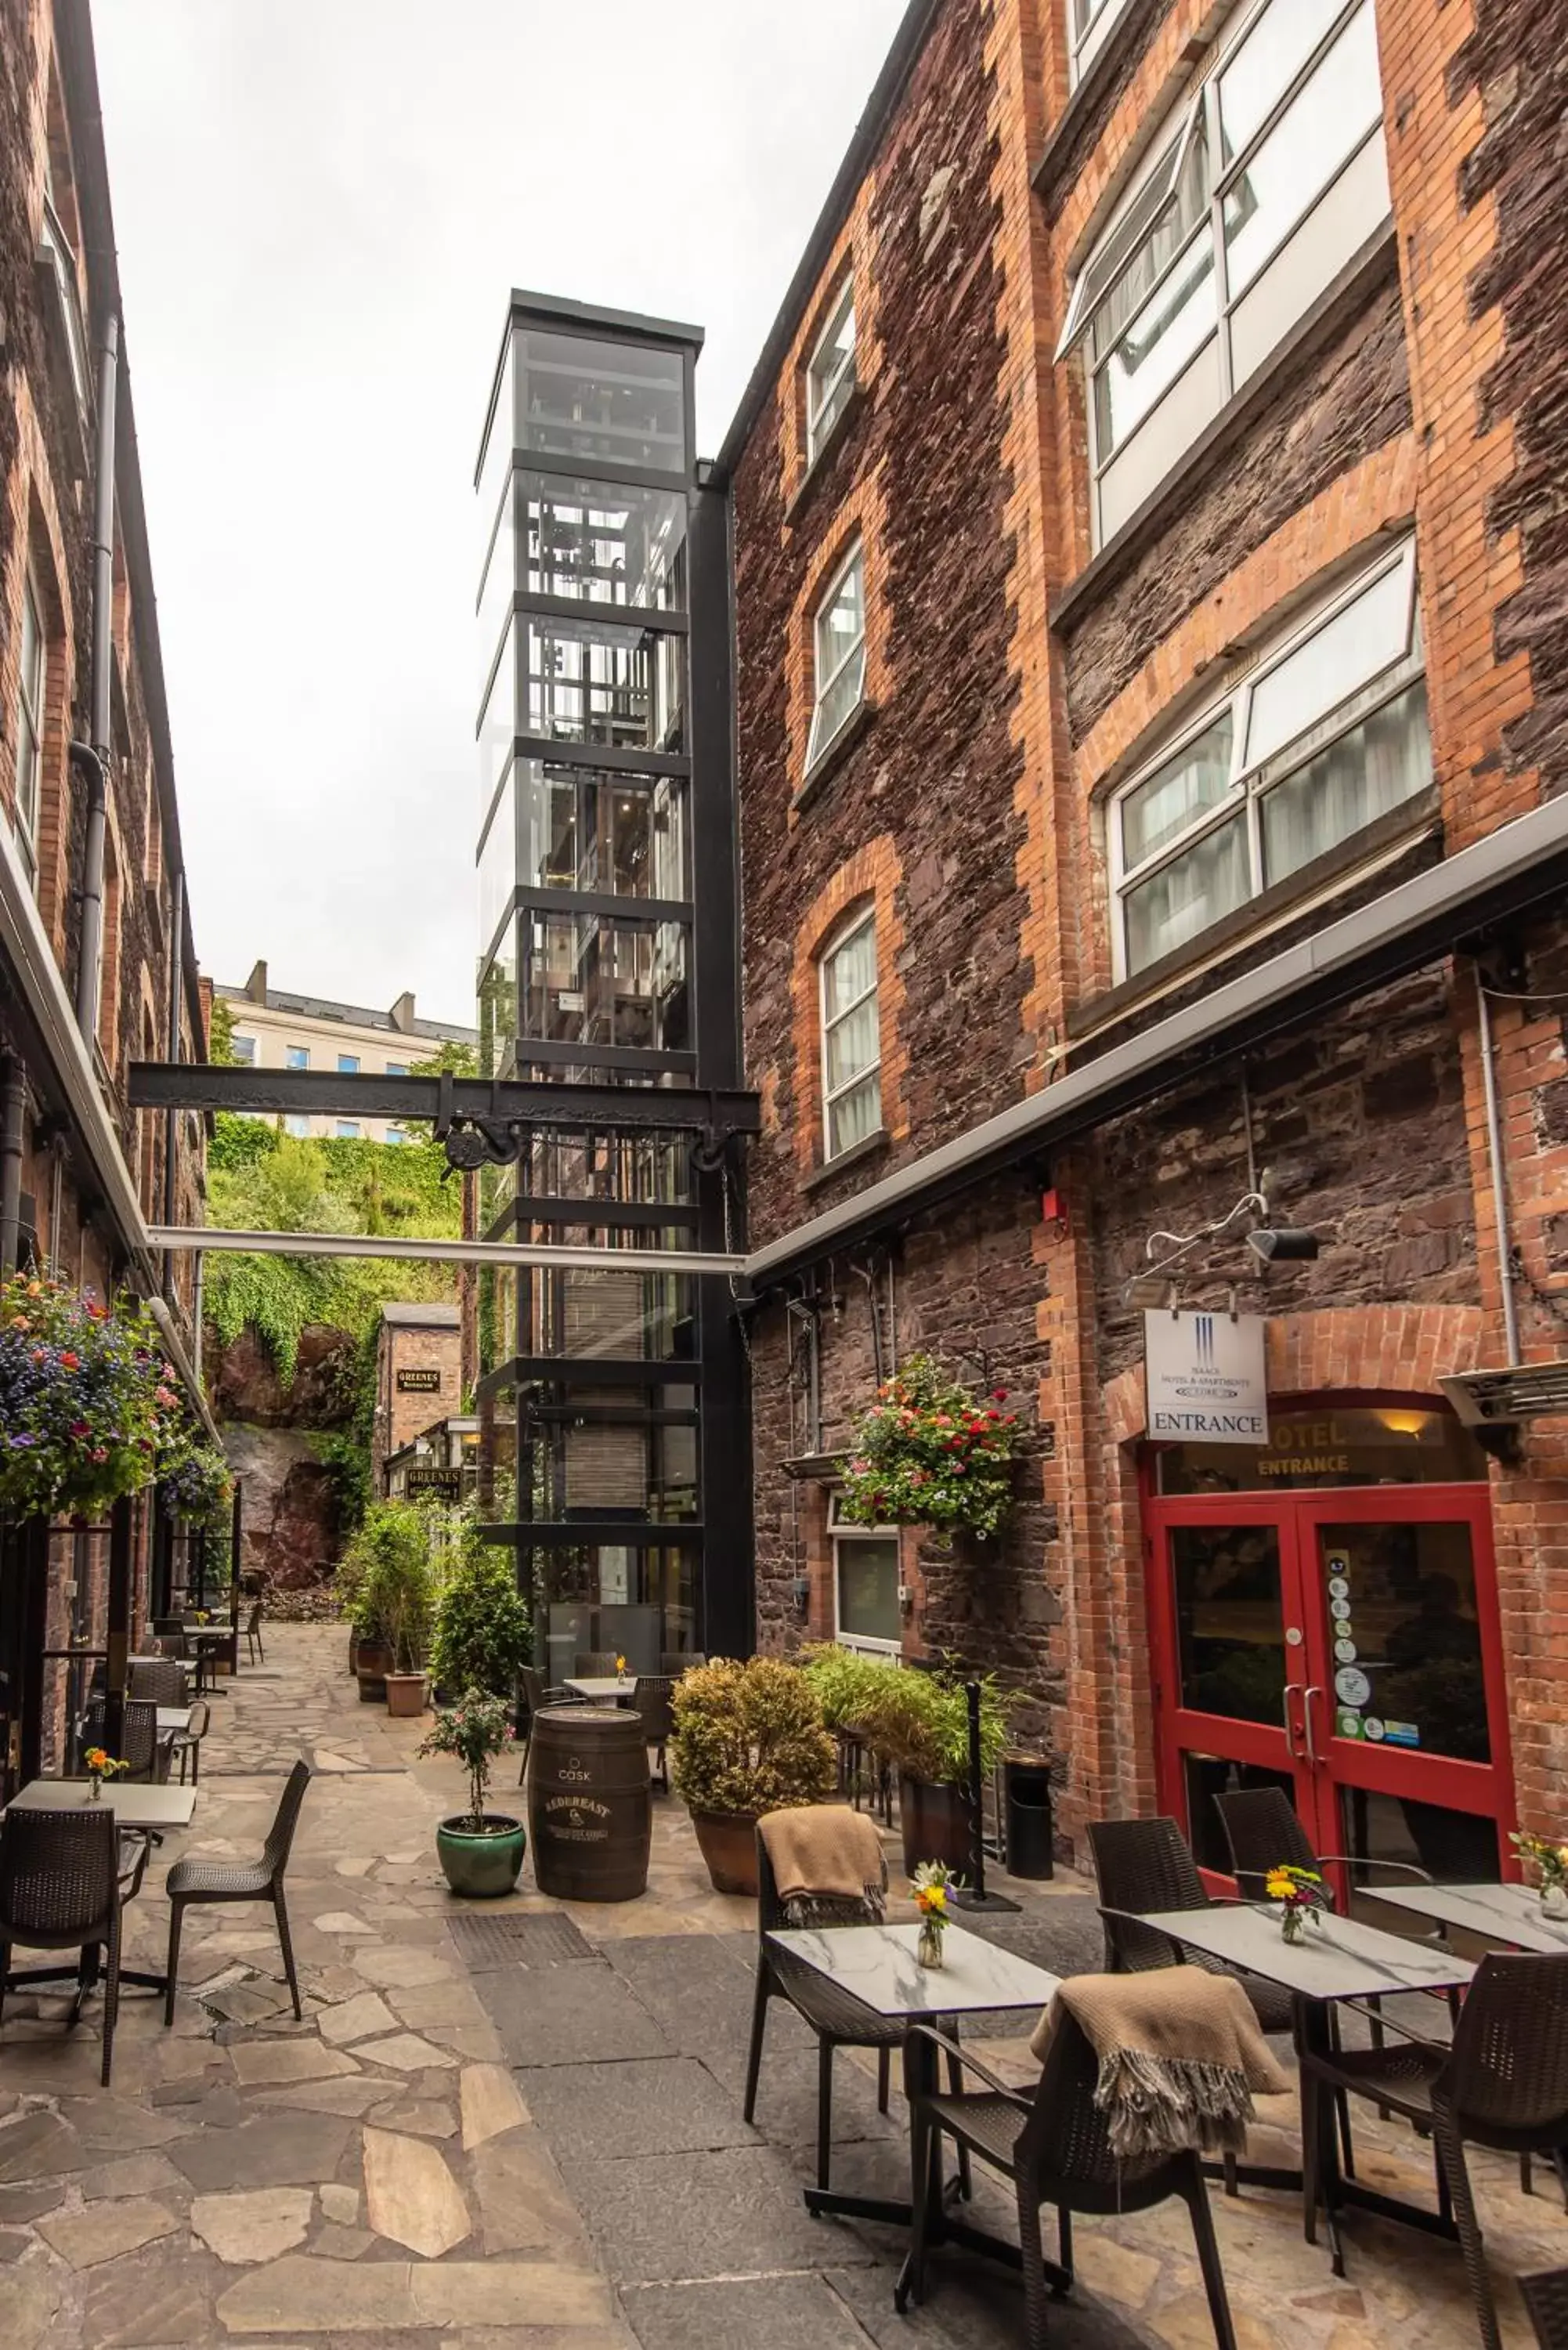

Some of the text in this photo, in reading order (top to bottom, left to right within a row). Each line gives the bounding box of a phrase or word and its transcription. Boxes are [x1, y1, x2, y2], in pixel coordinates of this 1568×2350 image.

[1162, 1375, 1188, 1384] HOTEL
[1154, 1412, 1263, 1434] ENTRANCE
[1257, 1421, 1346, 1452] OTEL
[1258, 1455, 1349, 1475] ENTRANCE
[410, 1472, 458, 1483] GREENES
